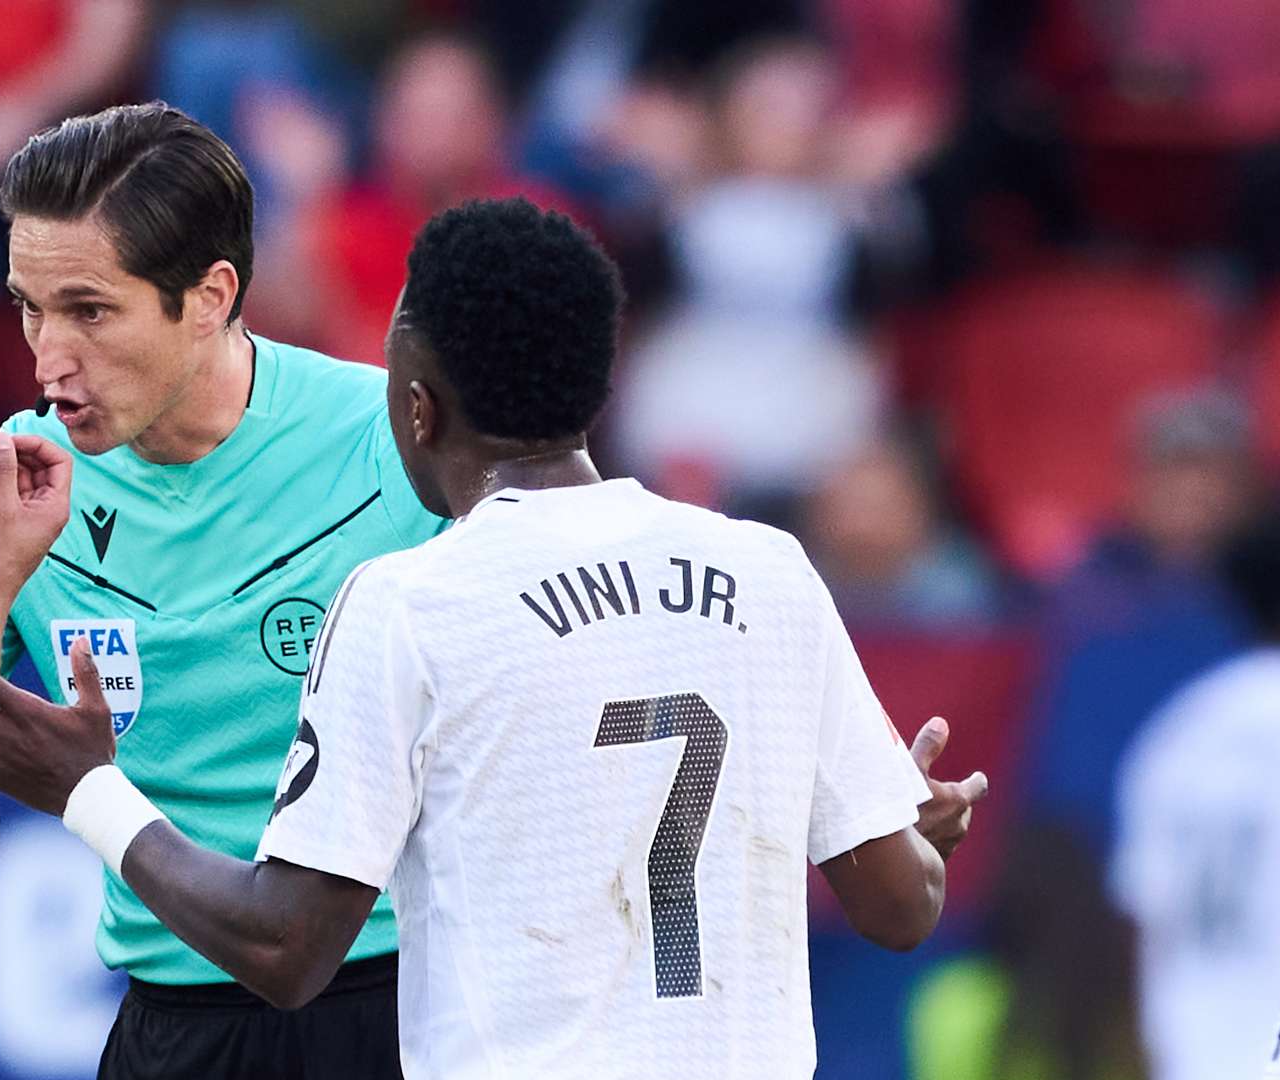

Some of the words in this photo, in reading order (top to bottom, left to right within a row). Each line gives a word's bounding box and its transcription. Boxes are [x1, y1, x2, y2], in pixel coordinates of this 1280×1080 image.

[519, 560, 641, 638] VINI
[658, 557, 748, 635] JR.
[58, 628, 129, 656] FFA
[67, 676, 135, 691] RREE
[593, 692, 727, 998] 7
